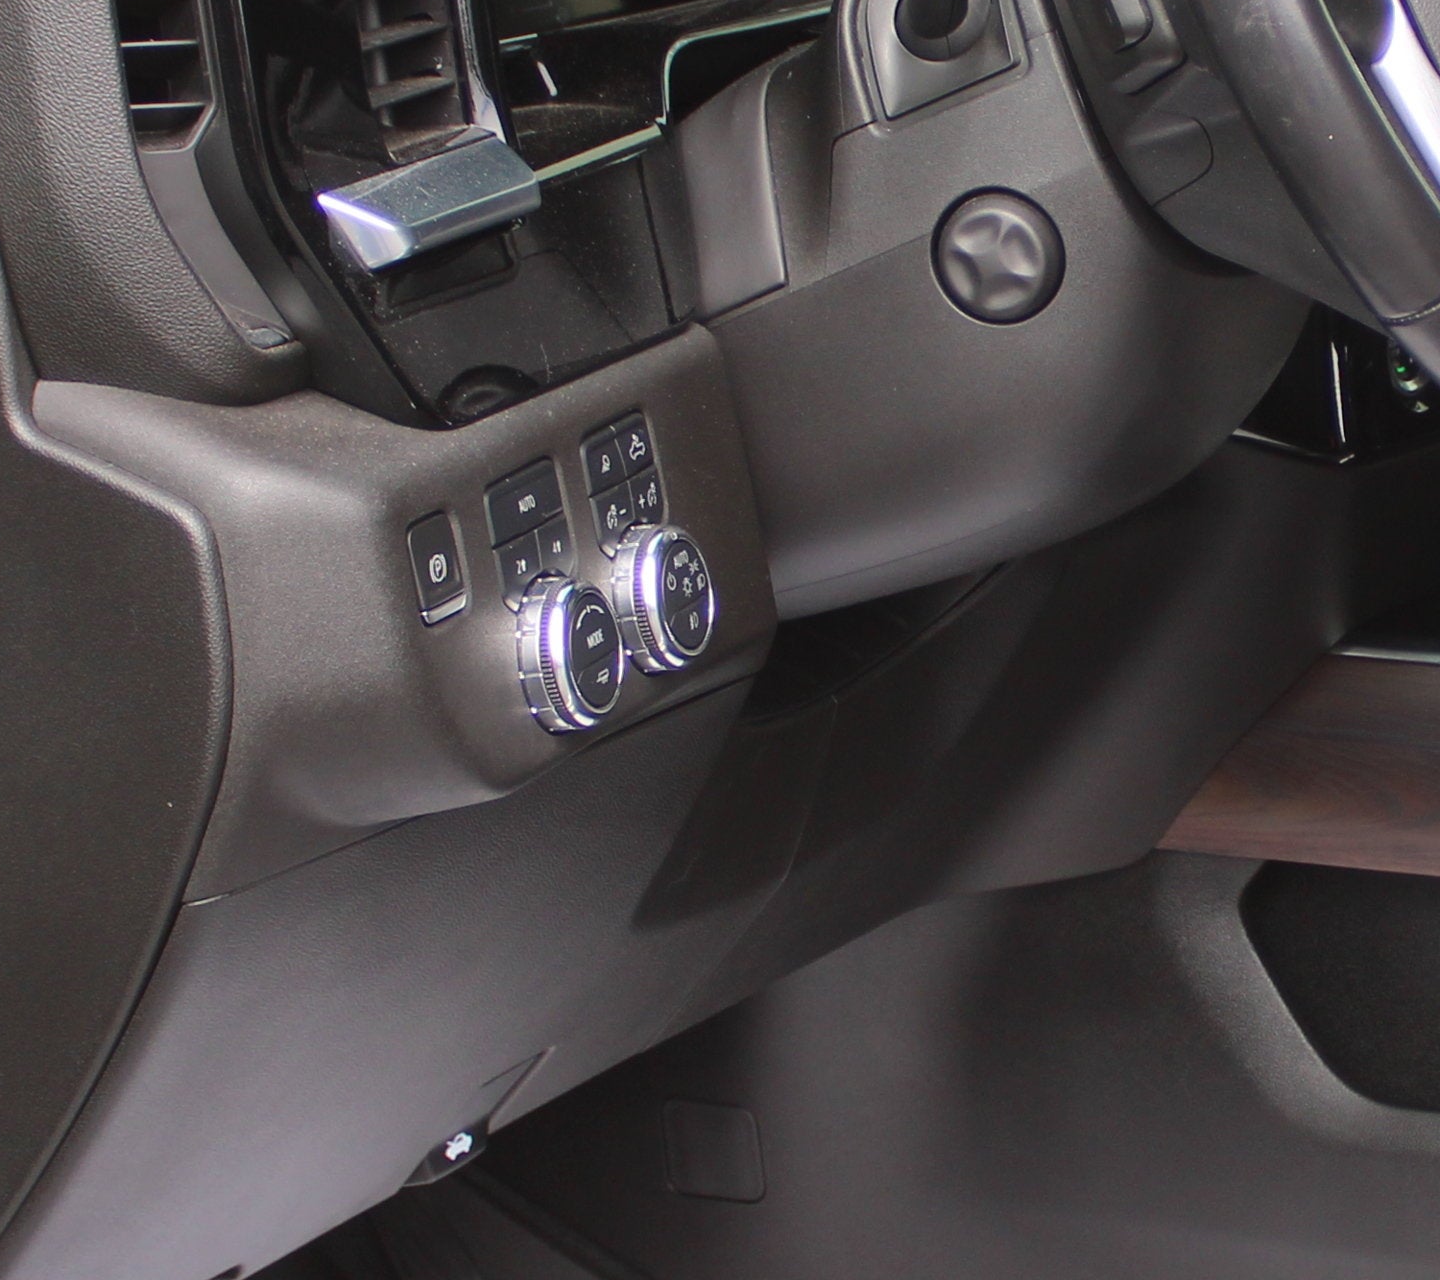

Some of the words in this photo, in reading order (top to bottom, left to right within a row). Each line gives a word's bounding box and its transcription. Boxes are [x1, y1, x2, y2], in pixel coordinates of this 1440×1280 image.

[517, 493, 537, 515] AUTO
[673, 549, 689, 570] AUTO
[586, 627, 605, 650] MODE
